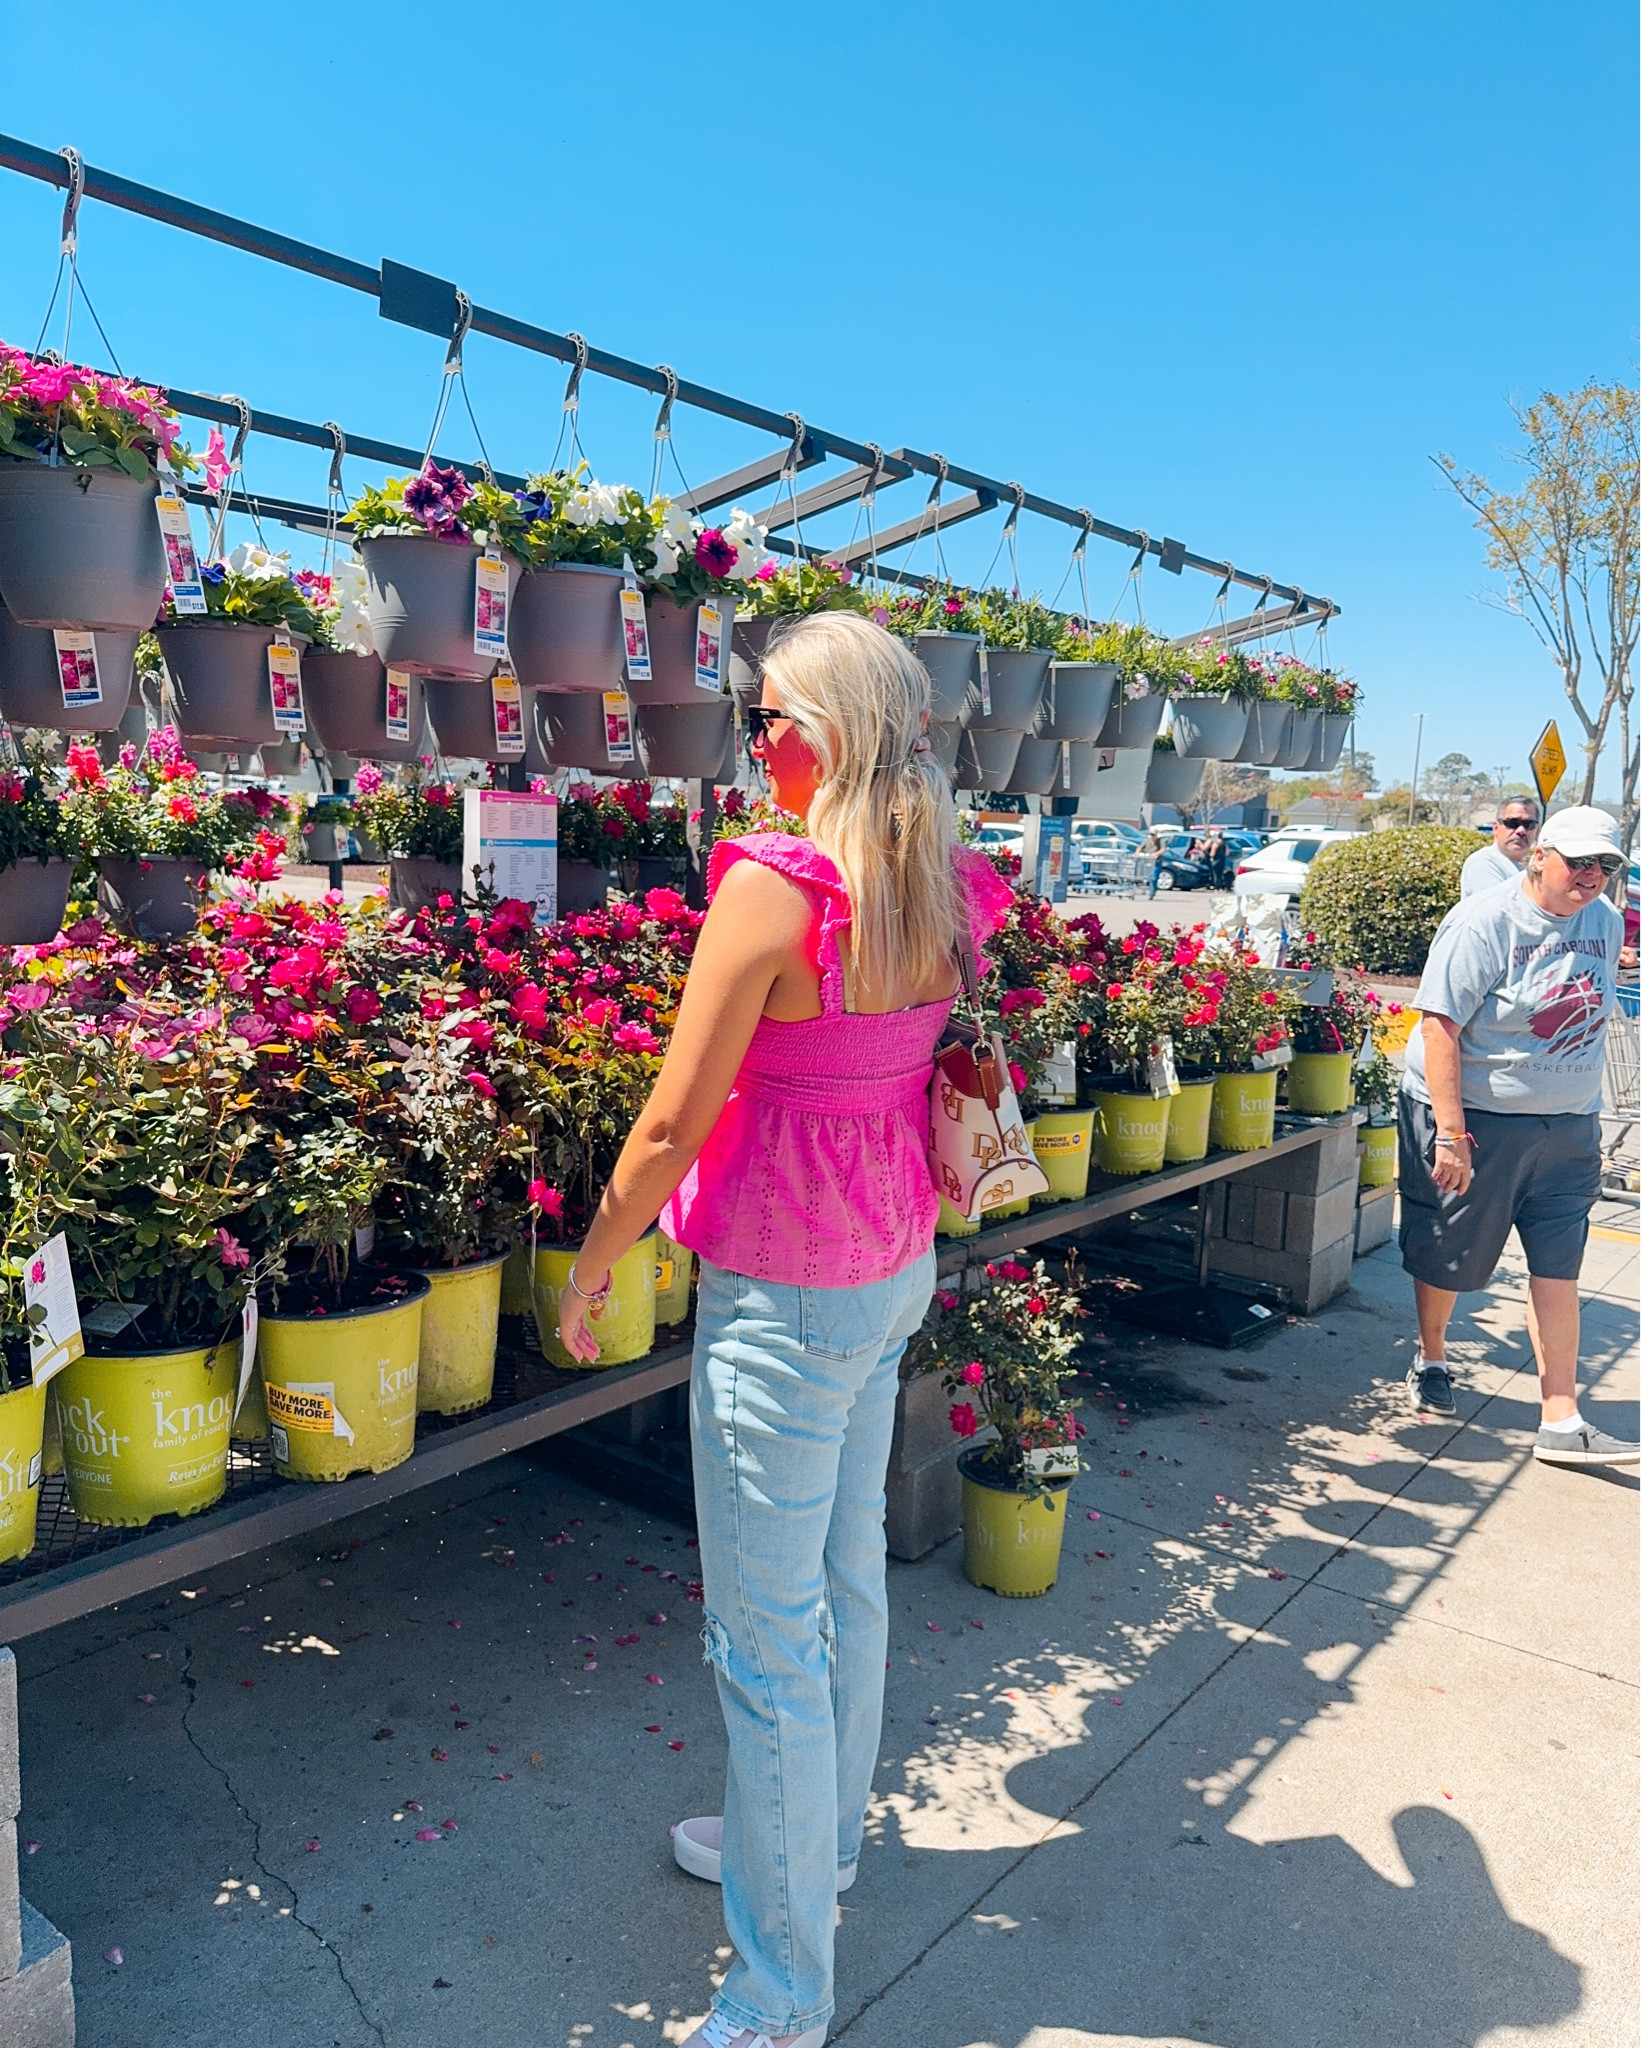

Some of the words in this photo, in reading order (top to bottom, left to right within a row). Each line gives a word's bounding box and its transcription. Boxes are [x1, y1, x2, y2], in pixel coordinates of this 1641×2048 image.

[1513, 943, 1551, 968] SOUTH
[1553, 938, 1606, 960] CAROLIN
[151, 1388, 172, 1399] the
[269, 1386, 287, 1402] BUY
[289, 1395, 324, 1410] MORE
[269, 1397, 292, 1414] SAVE
[294, 1406, 335, 1419] MORE.
[153, 1434, 187, 1449] family
[191, 1429, 202, 1441] of
[168, 1469, 197, 1482] Roses
